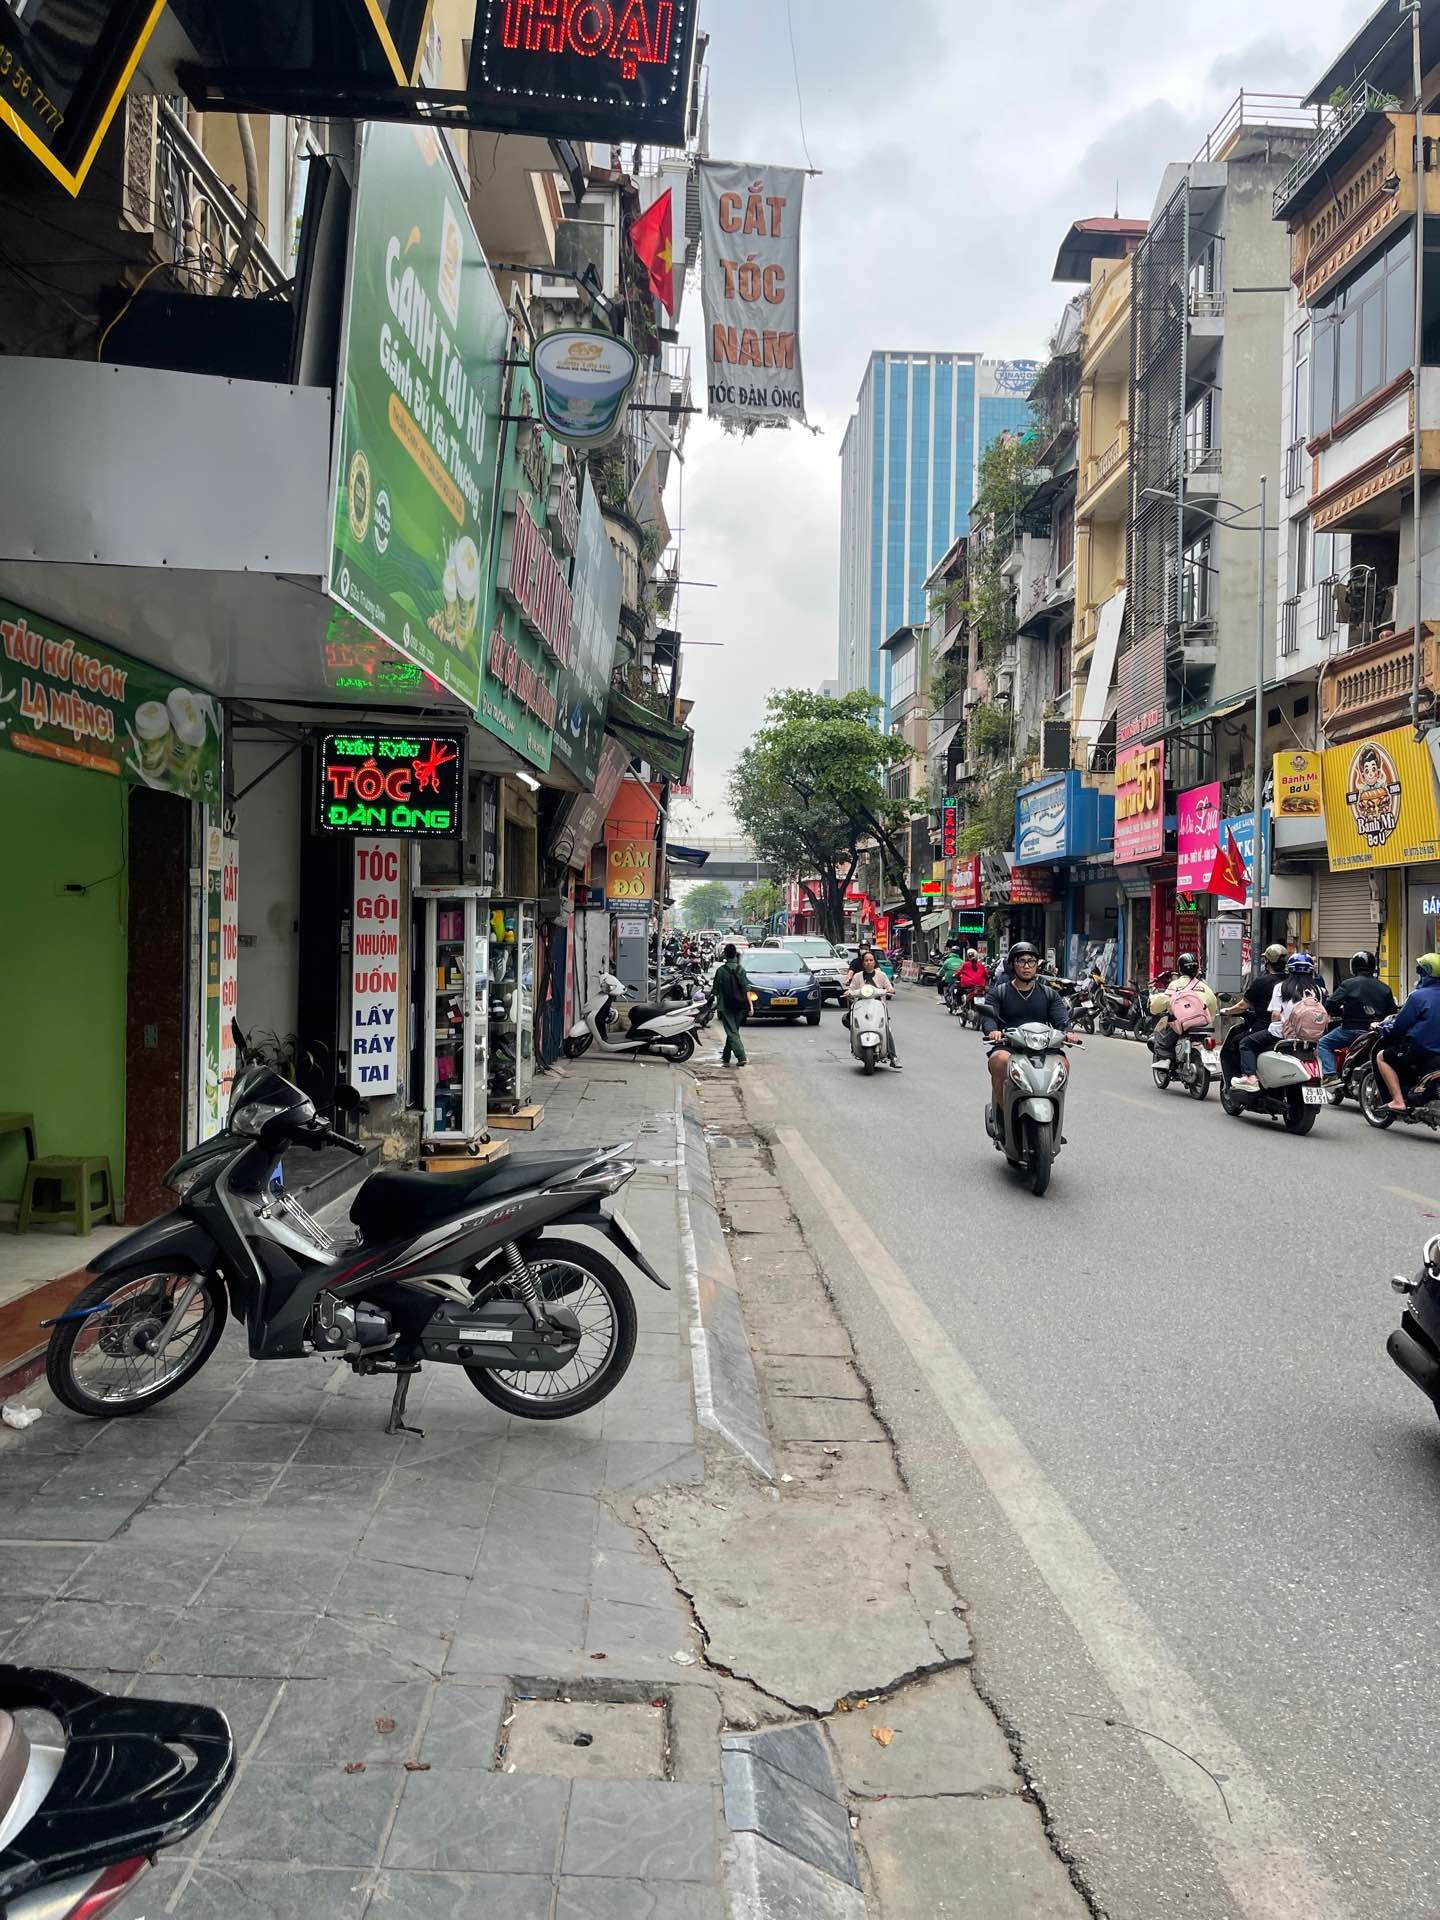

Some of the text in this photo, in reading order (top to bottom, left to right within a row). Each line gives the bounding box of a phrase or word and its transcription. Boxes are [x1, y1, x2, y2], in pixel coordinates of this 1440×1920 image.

[32, 87, 65, 133] 7777
[719, 179, 787, 238] CẮT
[719, 254, 785, 304] TÓC
[712, 323, 794, 370] NAM
[708, 381, 801, 409] TÓC ĐÀN ÔNG
[72, 651, 128, 704] NGON
[20, 676, 49, 731] LẠ
[1137, 747, 1160, 813] 55
[223, 808, 239, 833] 62
[328, 803, 450, 829] ĐÀN ÔNG
[356, 845, 398, 882] TÓC
[610, 843, 652, 869] CẦM
[223, 852, 239, 903] CẮT
[613, 872, 645, 897] ĐỒ
[356, 894, 398, 924] GỘI
[223, 915, 238, 961] TÓC
[355, 930, 398, 960] NHUỘM
[222, 976, 238, 1012] GỘI
[354, 964, 397, 994] UỐN
[355, 1003, 395, 1027] LẤY
[353, 1034, 396, 1055] RÁY
[358, 1064, 389, 1083] TAI
